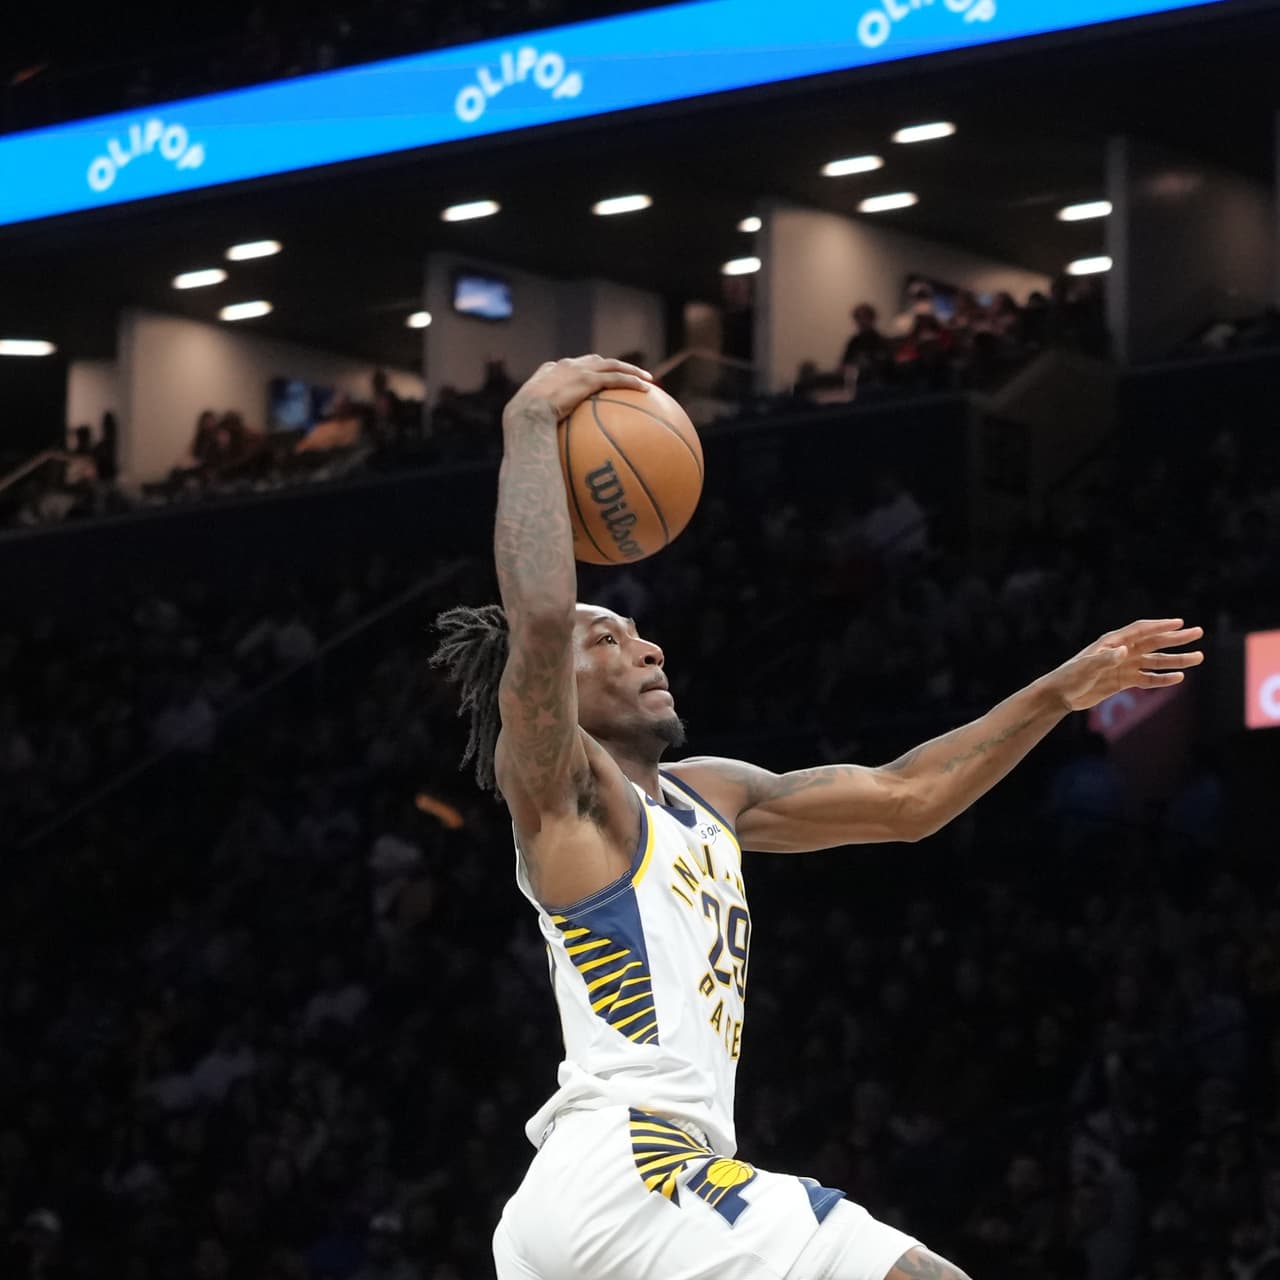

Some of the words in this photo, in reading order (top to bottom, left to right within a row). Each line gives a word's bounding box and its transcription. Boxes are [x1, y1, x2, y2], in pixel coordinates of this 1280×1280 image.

[455, 47, 582, 122] OLIPOP
[87, 118, 205, 191] OLIPOP
[701, 889, 751, 1002] 29
